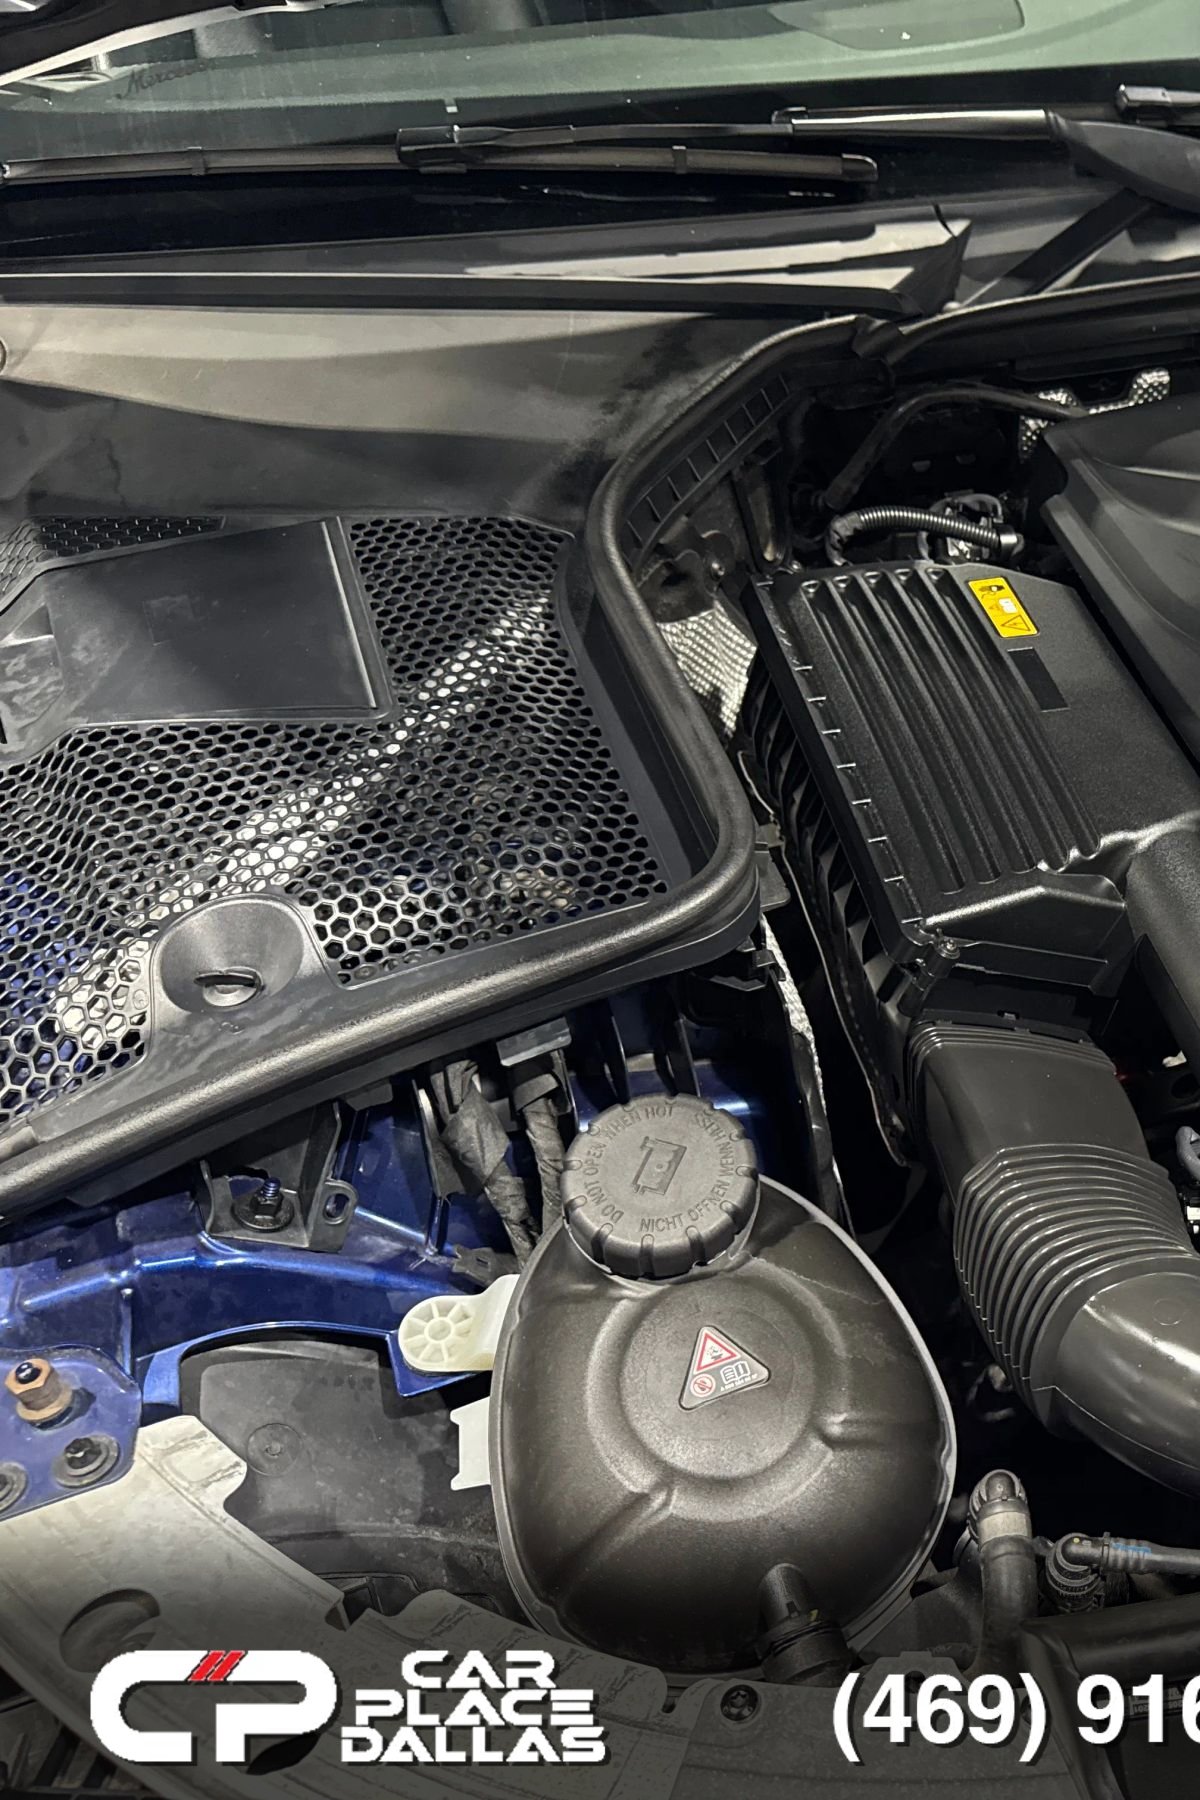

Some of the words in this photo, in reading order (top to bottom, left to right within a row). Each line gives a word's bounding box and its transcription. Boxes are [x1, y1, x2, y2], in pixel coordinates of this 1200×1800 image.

[603, 1110, 642, 1140] WHEN
[644, 1105, 675, 1120] HOT
[583, 1141, 607, 1176] OPEN
[584, 1180, 608, 1207] NOT
[639, 1214, 685, 1233] NICHT
[719, 1141, 735, 1178] WENN
[603, 1203, 625, 1224] DO
